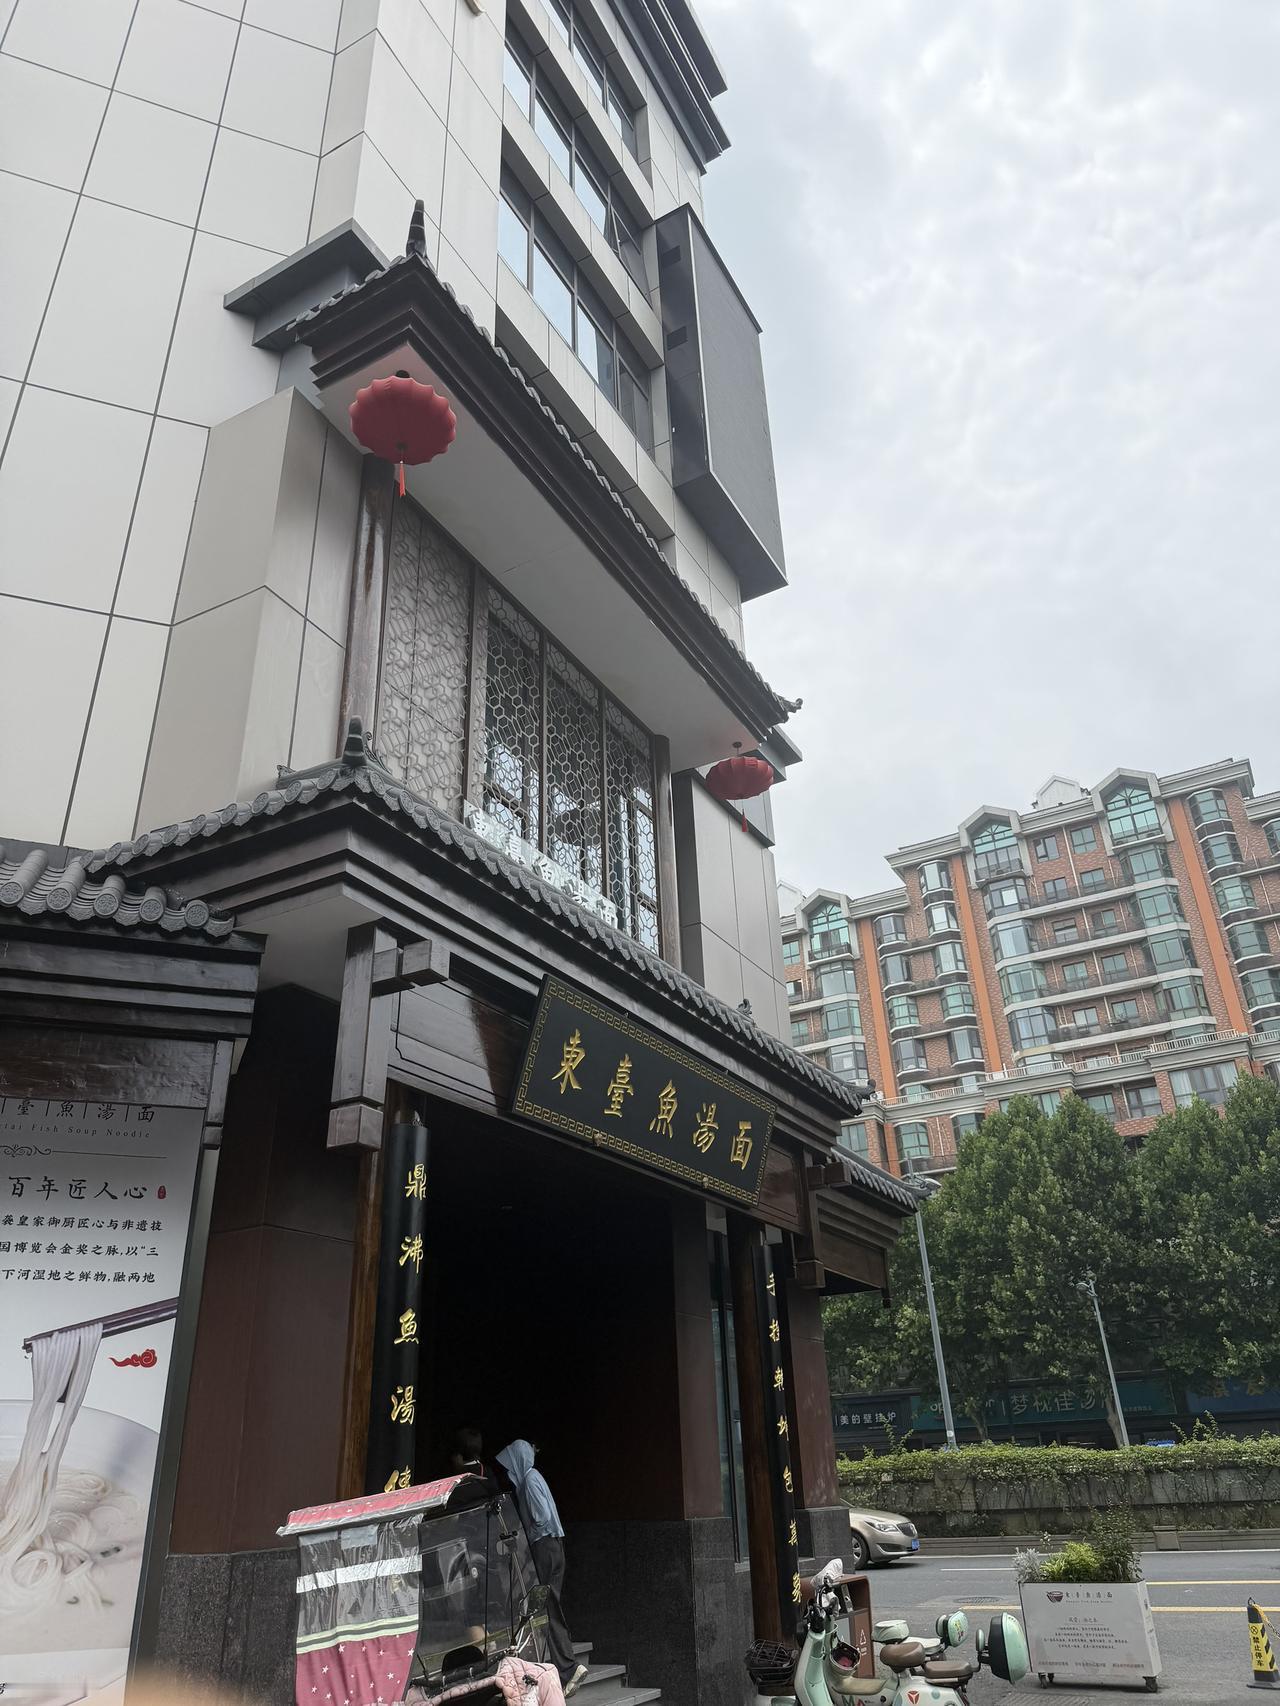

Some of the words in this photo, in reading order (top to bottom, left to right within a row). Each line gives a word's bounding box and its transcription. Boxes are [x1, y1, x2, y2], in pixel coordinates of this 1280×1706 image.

[551, 1028, 753, 1170] 東臺魚湯面
[67, 1126, 97, 1136] Soup
[8, 1176, 148, 1200] 百年匠人心
